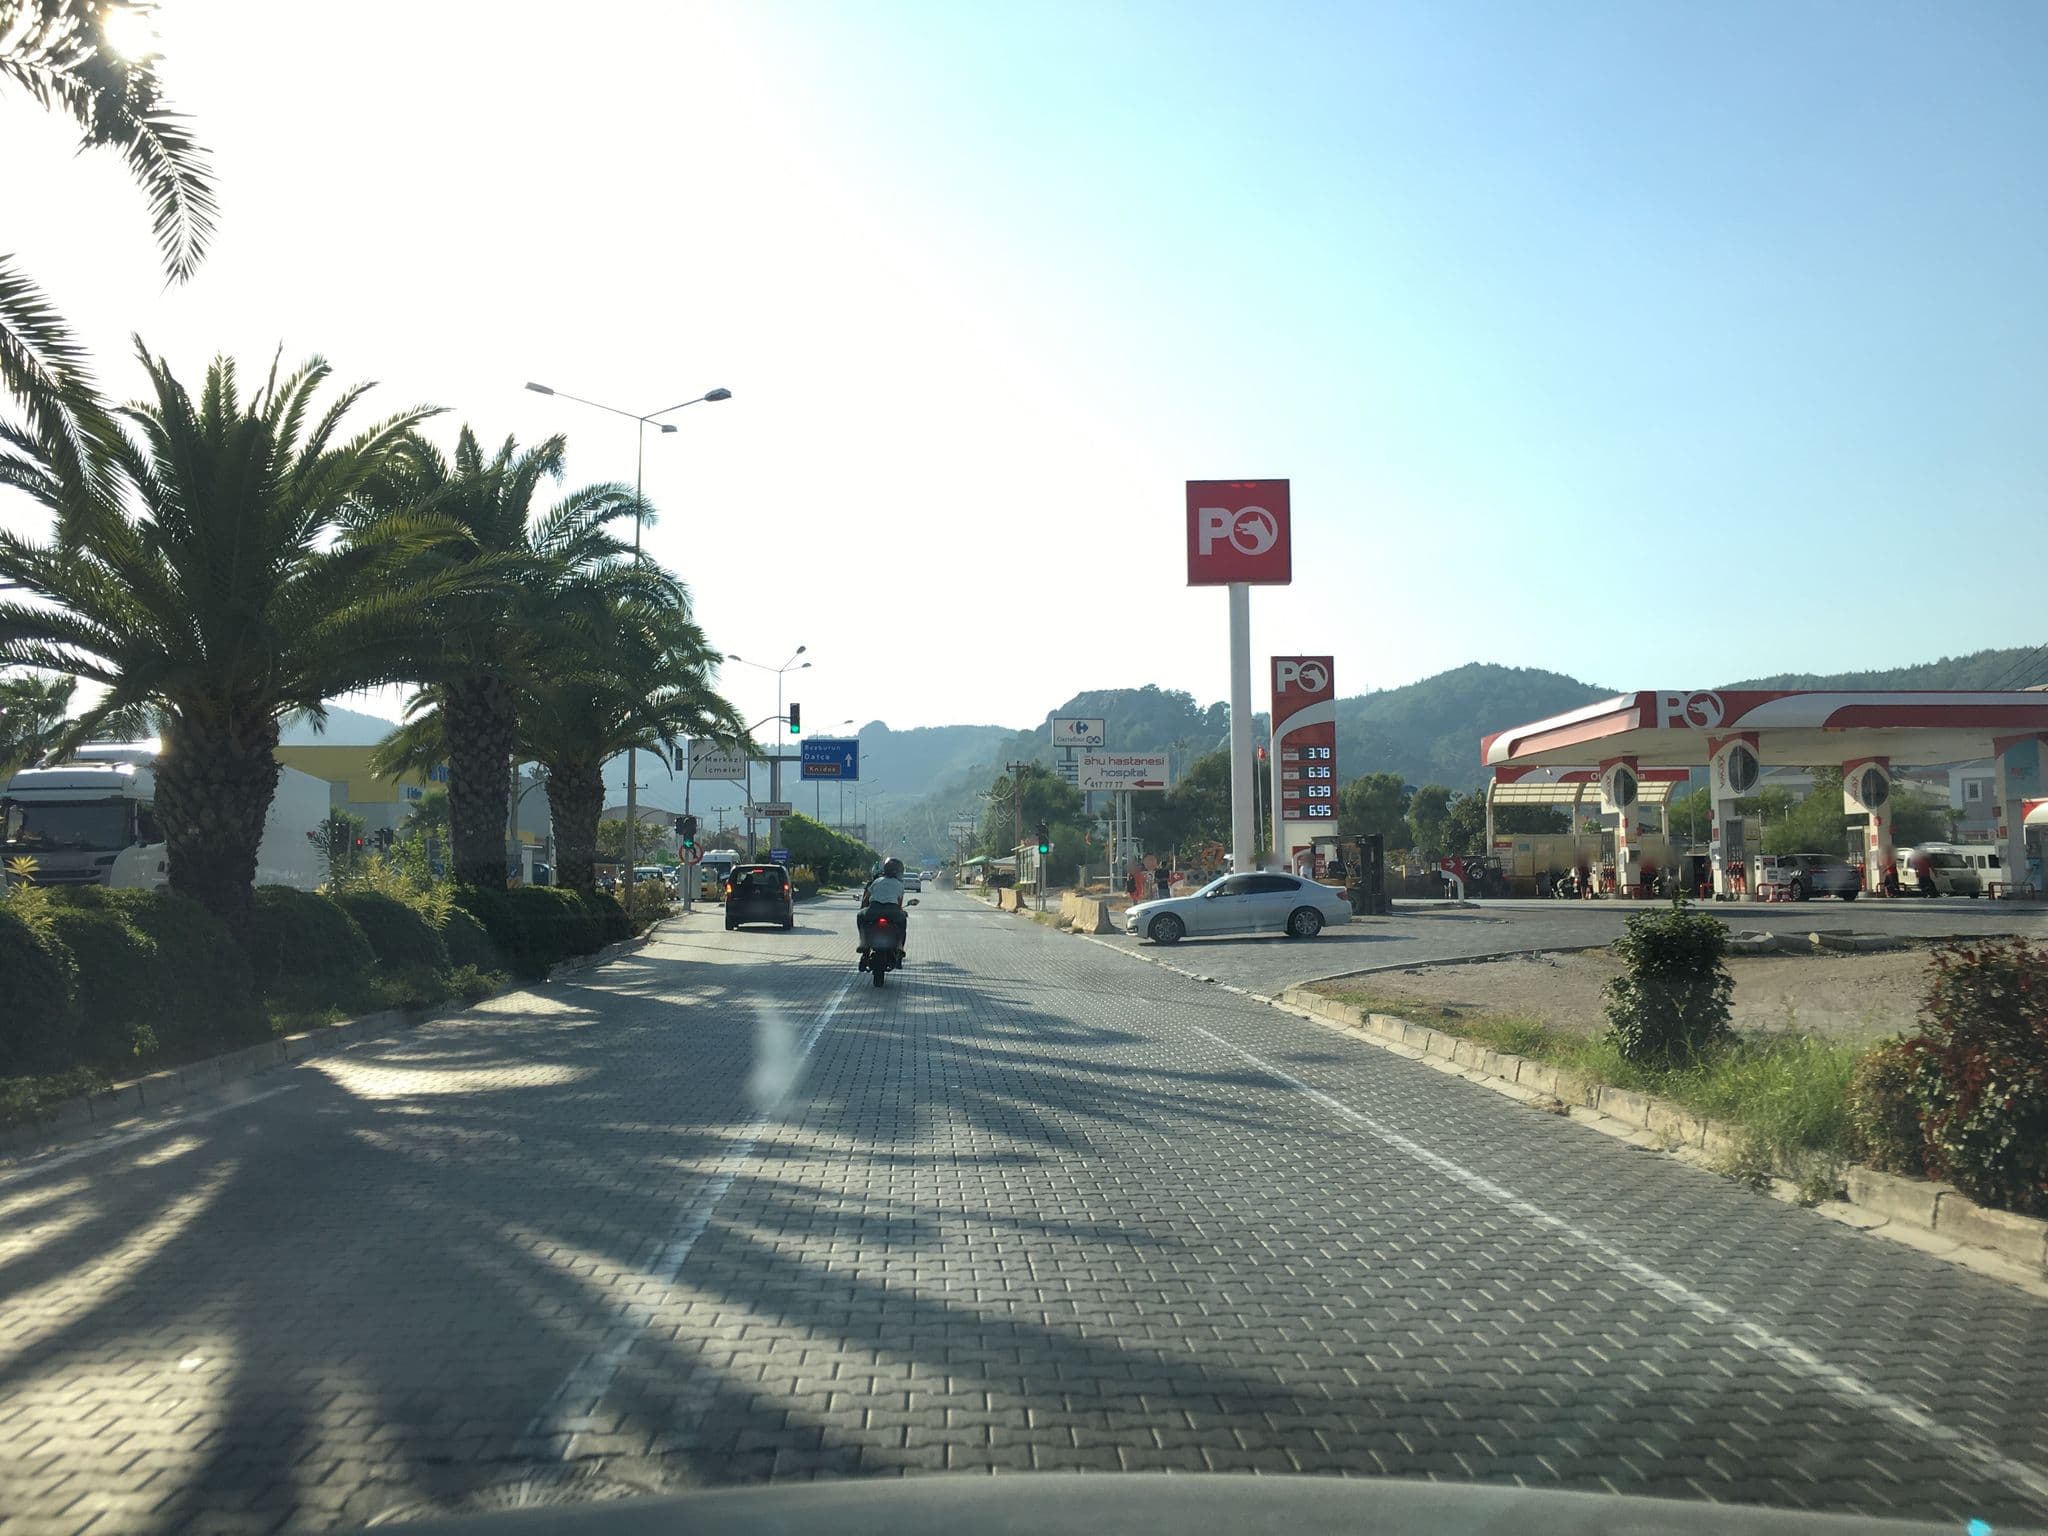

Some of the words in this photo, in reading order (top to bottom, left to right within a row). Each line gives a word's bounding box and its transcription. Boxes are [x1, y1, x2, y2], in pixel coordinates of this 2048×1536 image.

[1084, 757, 1106, 766] ahu
[1109, 757, 1165, 766] hastanesi
[1101, 768, 1148, 779] hospital
